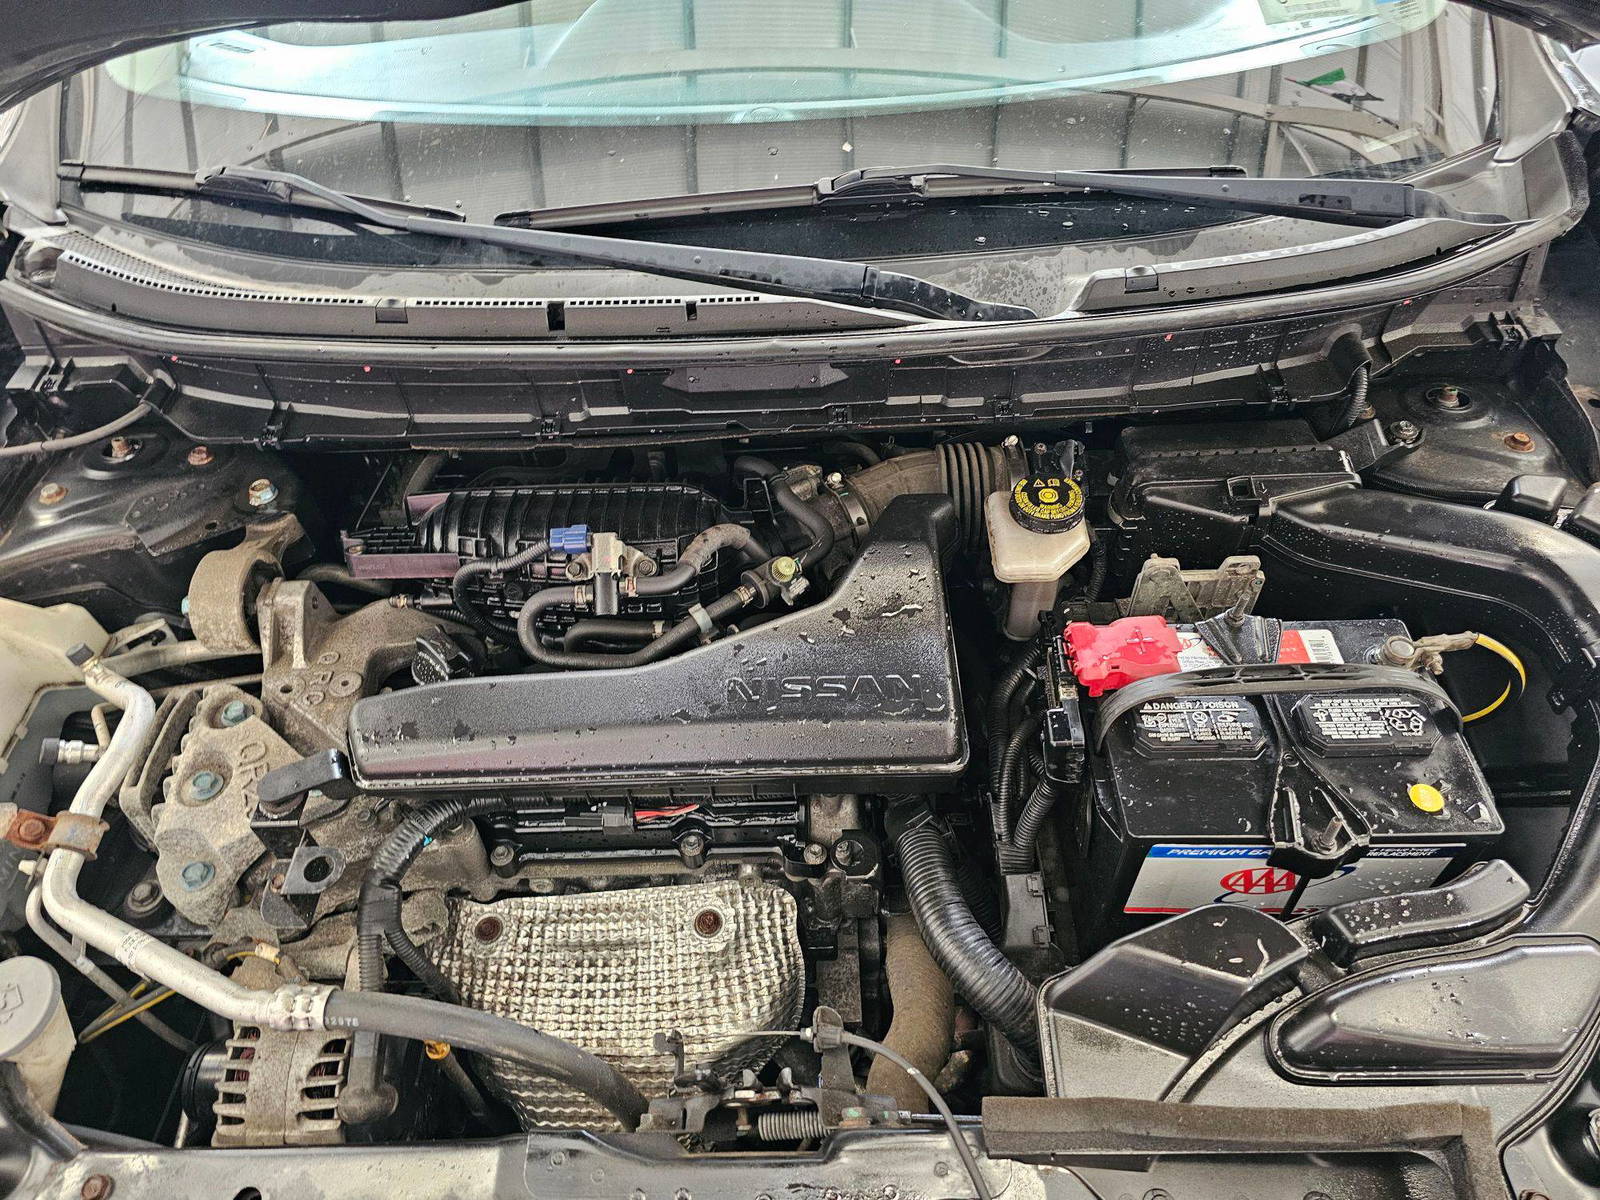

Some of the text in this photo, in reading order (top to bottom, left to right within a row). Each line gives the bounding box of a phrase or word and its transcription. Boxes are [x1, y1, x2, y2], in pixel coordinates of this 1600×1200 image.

[725, 674, 923, 703] NISSAN
[1153, 701, 1193, 710] DANGER
[1202, 700, 1239, 709] POISON
[1167, 848, 1247, 856] PREMIUM
[1226, 867, 1296, 894] AAA
